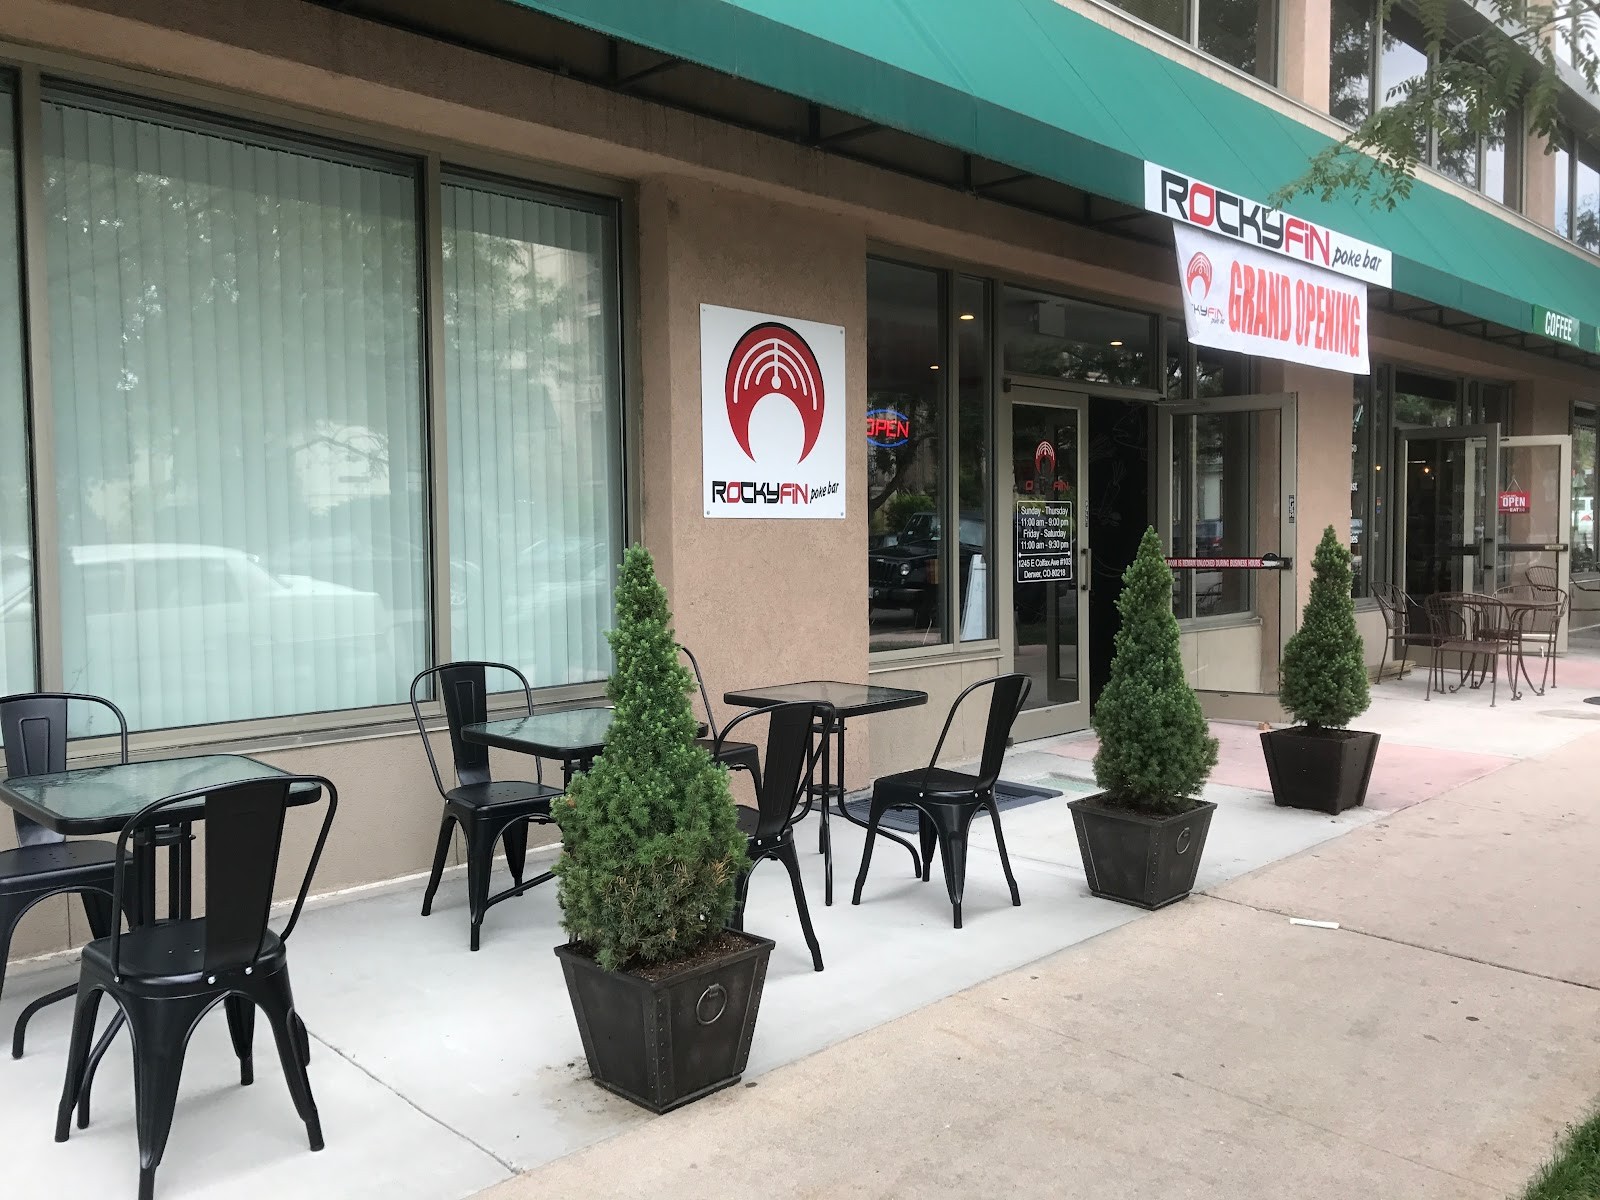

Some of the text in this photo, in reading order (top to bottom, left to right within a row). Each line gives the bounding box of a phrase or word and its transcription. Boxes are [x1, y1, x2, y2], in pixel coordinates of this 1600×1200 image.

[1332, 246, 1361, 267] poke
[1362, 249, 1382, 272] bar
[1228, 260, 1361, 358] GRAND OPENING
[1545, 311, 1572, 342] COFFEE
[809, 487, 827, 504] poke
[827, 480, 840, 495] bar
[1502, 497, 1526, 507] OPEN
[1020, 506, 1041, 517] Sunday
[1045, 506, 1069, 517] Thursday
[1020, 518, 1035, 526] 11:00
[1048, 518, 1060, 526] 9:00
[1060, 519, 1069, 528] pm
[1023, 529, 1040, 540] Friday
[1044, 529, 1067, 539] Saturday
[1020, 541, 1035, 549] 11:00
[1048, 540, 1060, 549] 9:30
[1060, 542, 1069, 550] pm
[1019, 559, 1030, 567] 1245
[1031, 559, 1035, 567] E
[1035, 559, 1051, 567] Colfax
[1051, 558, 1060, 566] Ave
